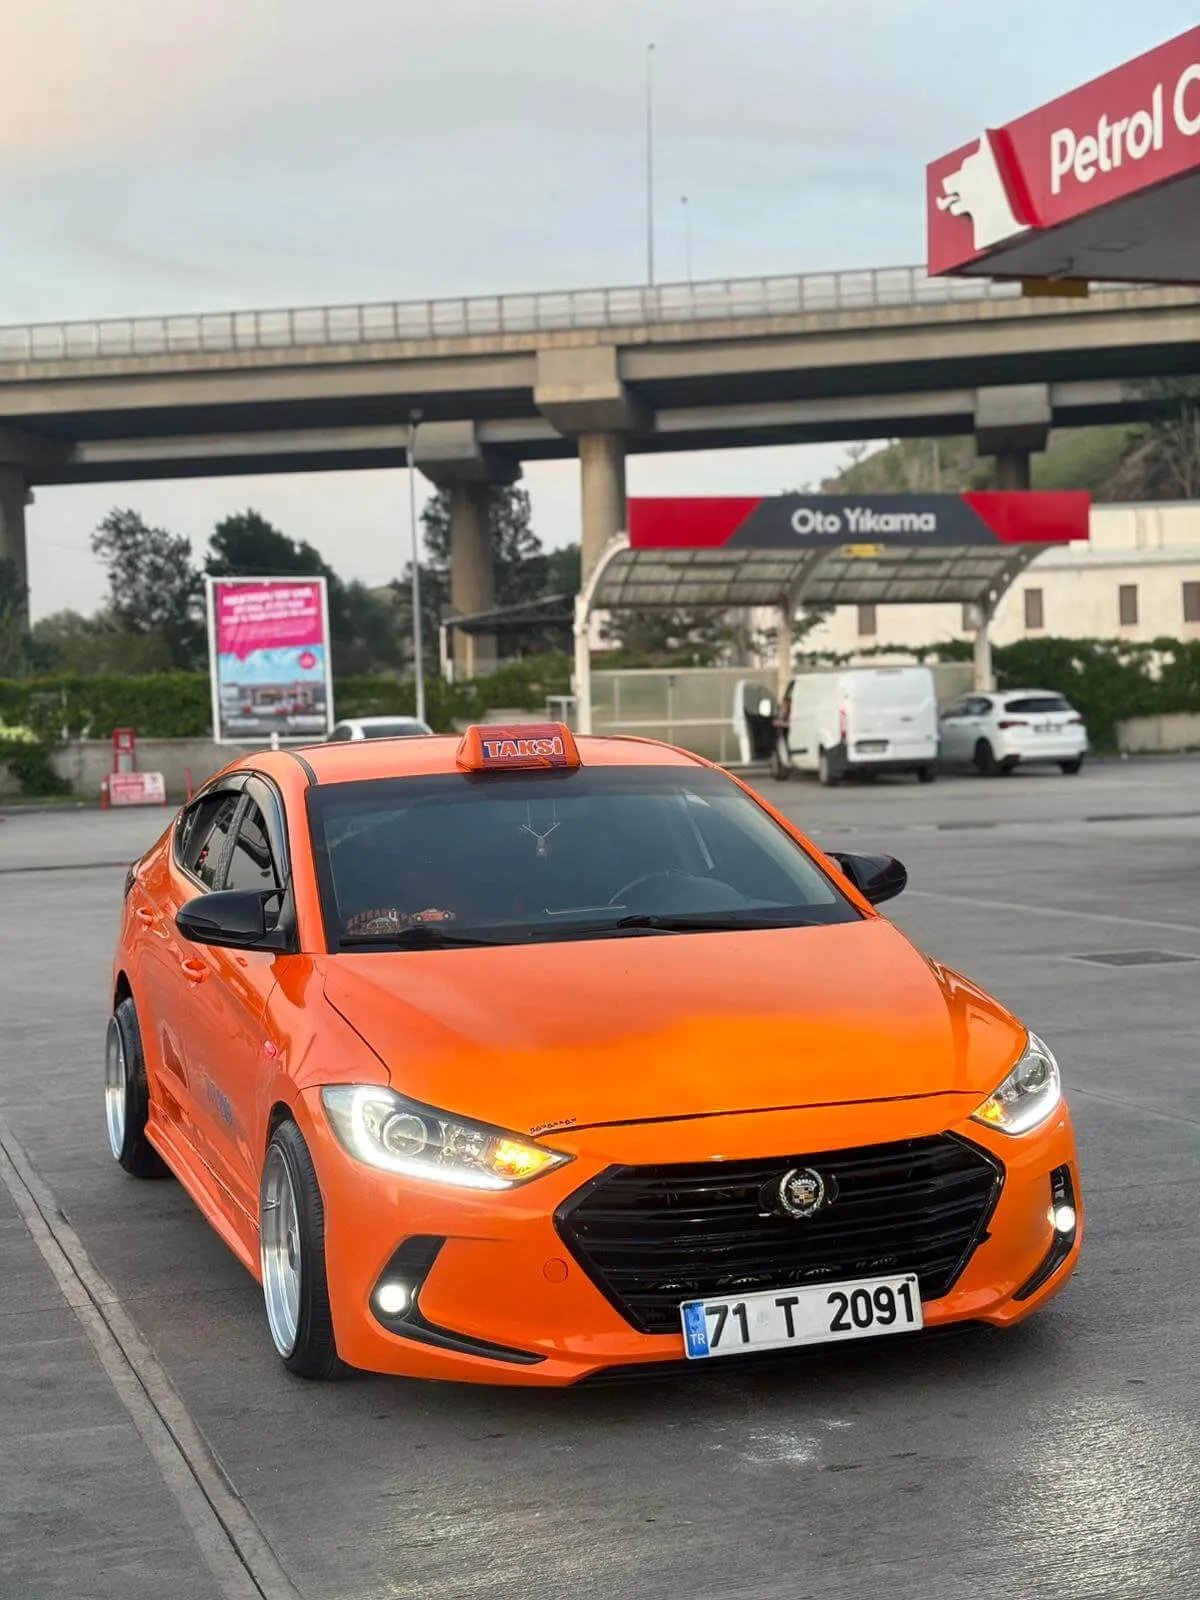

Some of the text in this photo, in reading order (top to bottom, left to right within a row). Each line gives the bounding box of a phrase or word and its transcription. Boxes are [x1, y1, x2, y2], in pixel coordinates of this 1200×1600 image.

[1050, 83, 1163, 196] Petrol
[791, 508, 842, 535] Oto
[704, 1282, 915, 1348] 71 T 2091
[690, 1333, 706, 1346] TR
